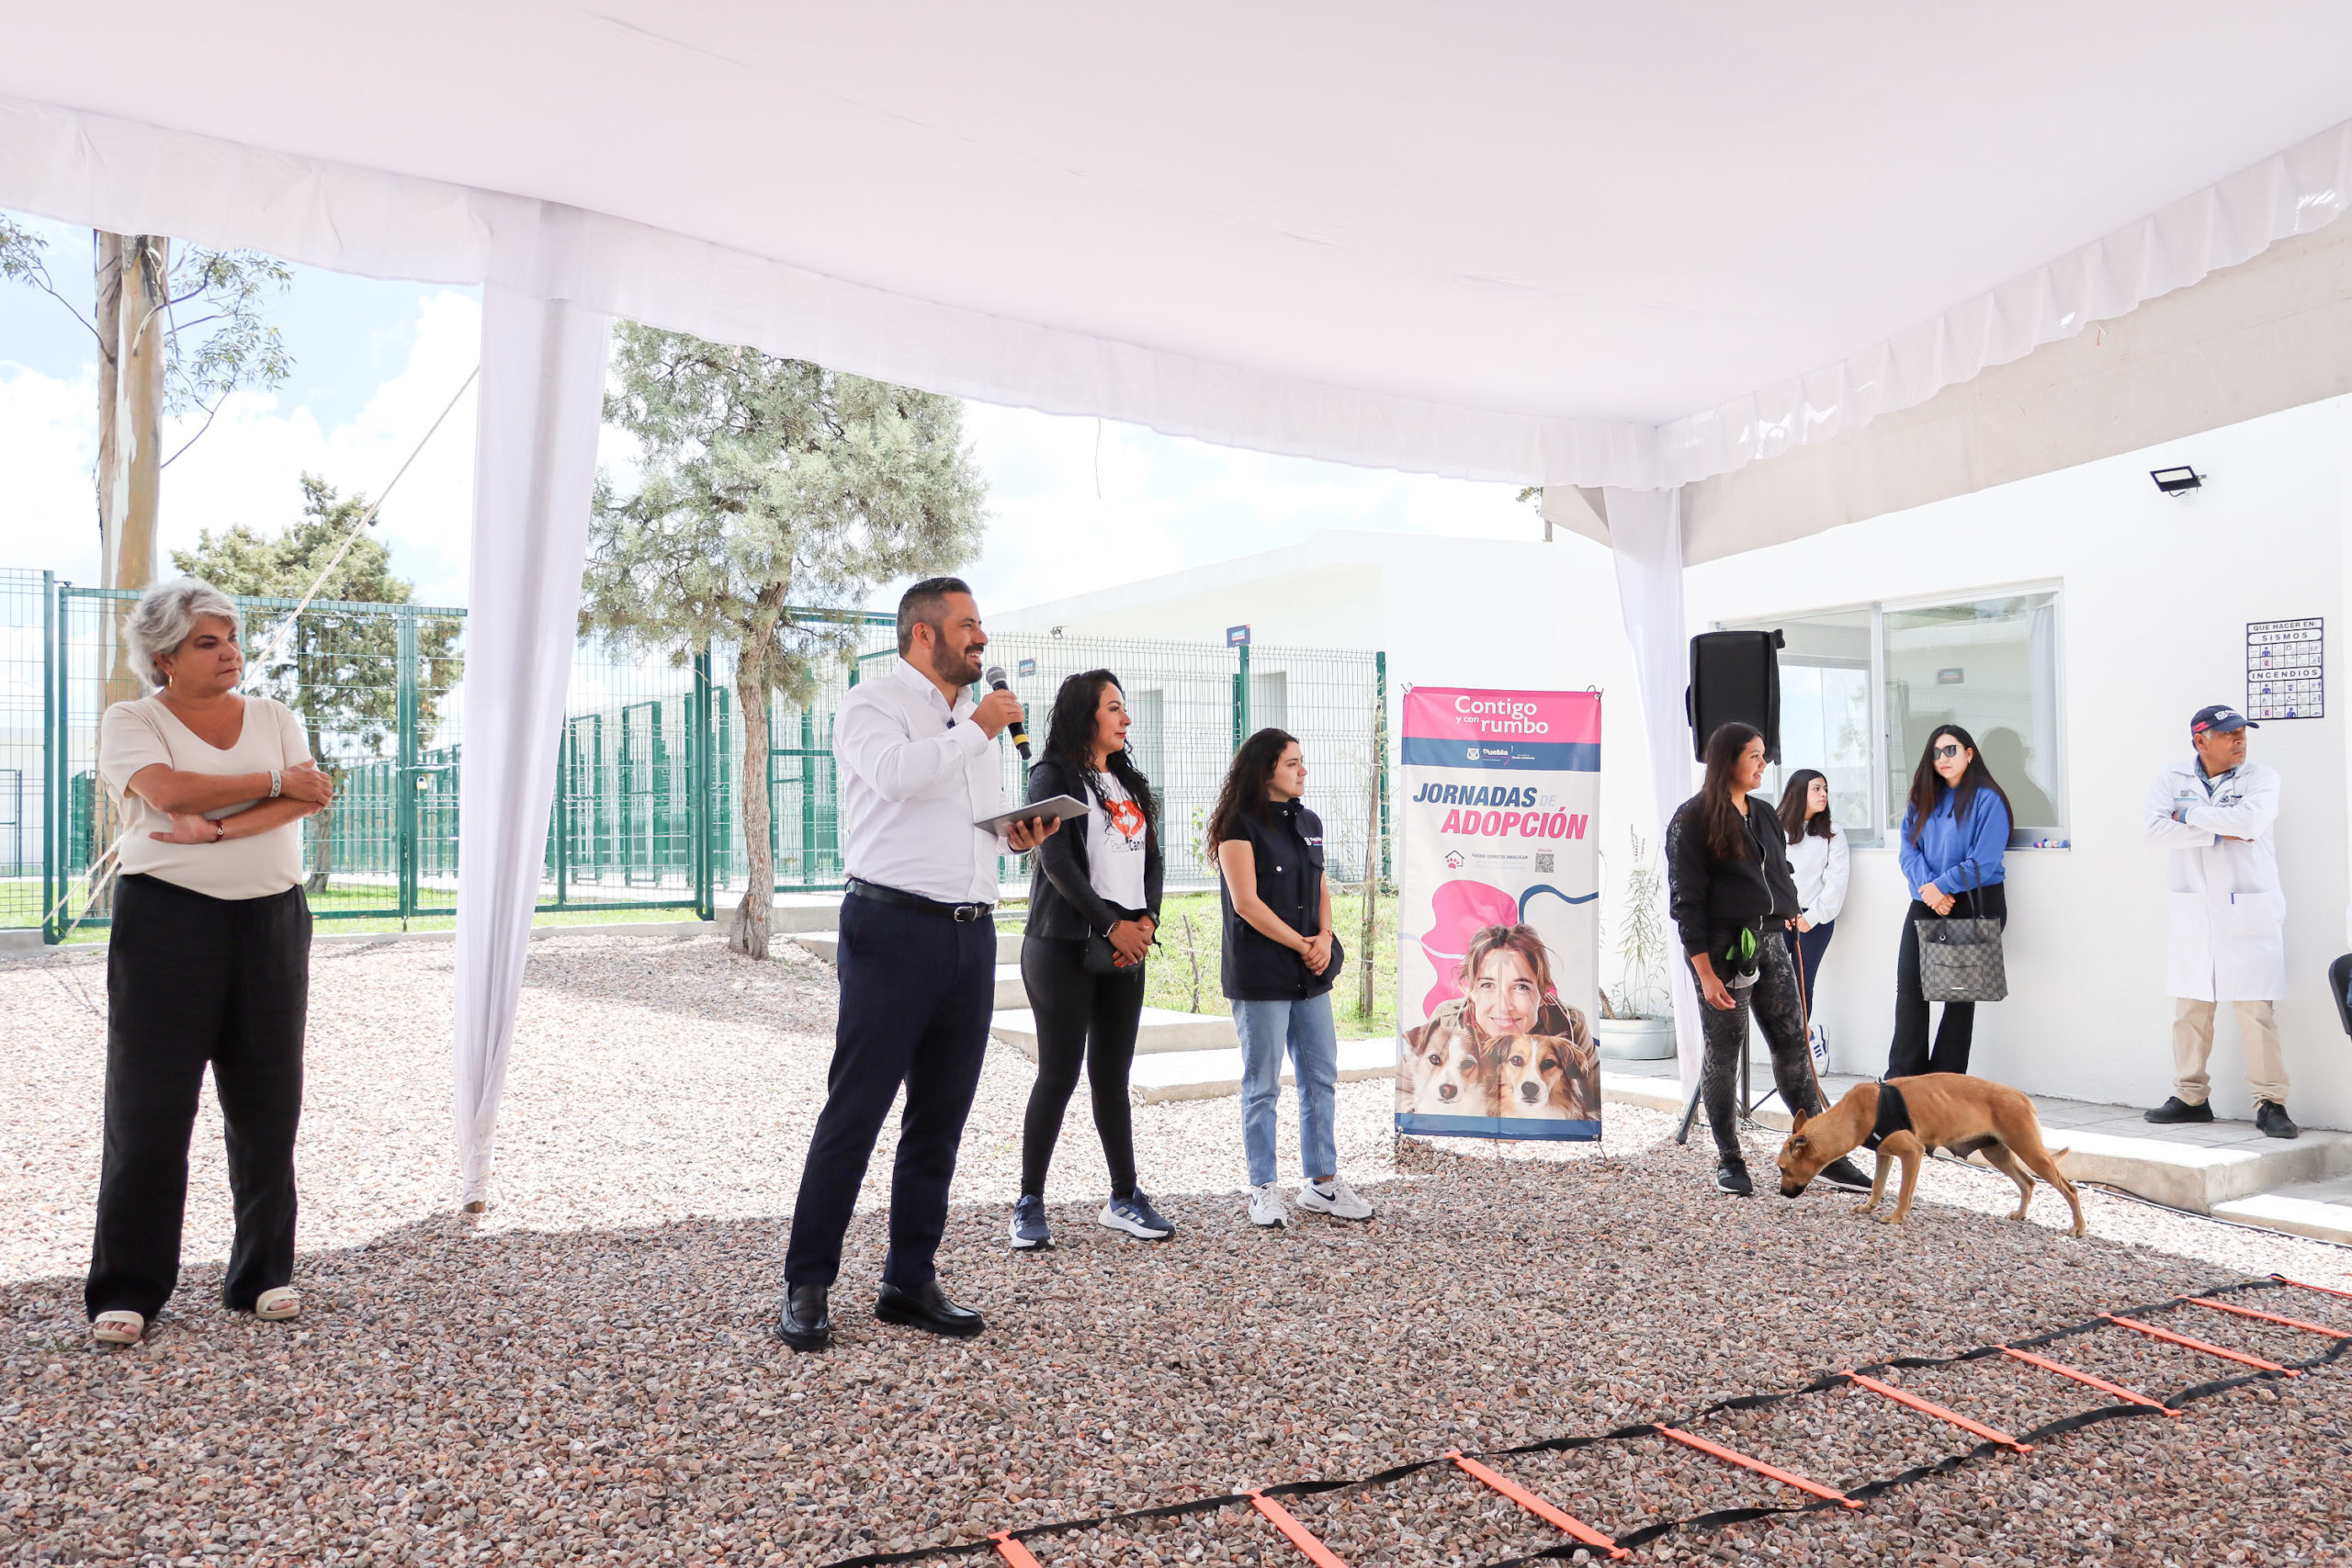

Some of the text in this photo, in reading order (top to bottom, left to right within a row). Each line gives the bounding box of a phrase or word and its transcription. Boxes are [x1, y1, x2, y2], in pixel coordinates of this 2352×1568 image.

[2253, 624, 2270, 632] QUE
[2272, 622, 2301, 630] HACER
[2262, 632, 2308, 642] SISMOS
[2252, 669, 2318, 680] INCENDIOS
[1454, 695, 1538, 720] Contigo
[1455, 716, 1549, 734] y con rumbo
[1482, 748, 1509, 756] Puebla
[1412, 783, 1557, 808] JORNADAS DE
[1440, 807, 1589, 840] ADOPCIÓN
